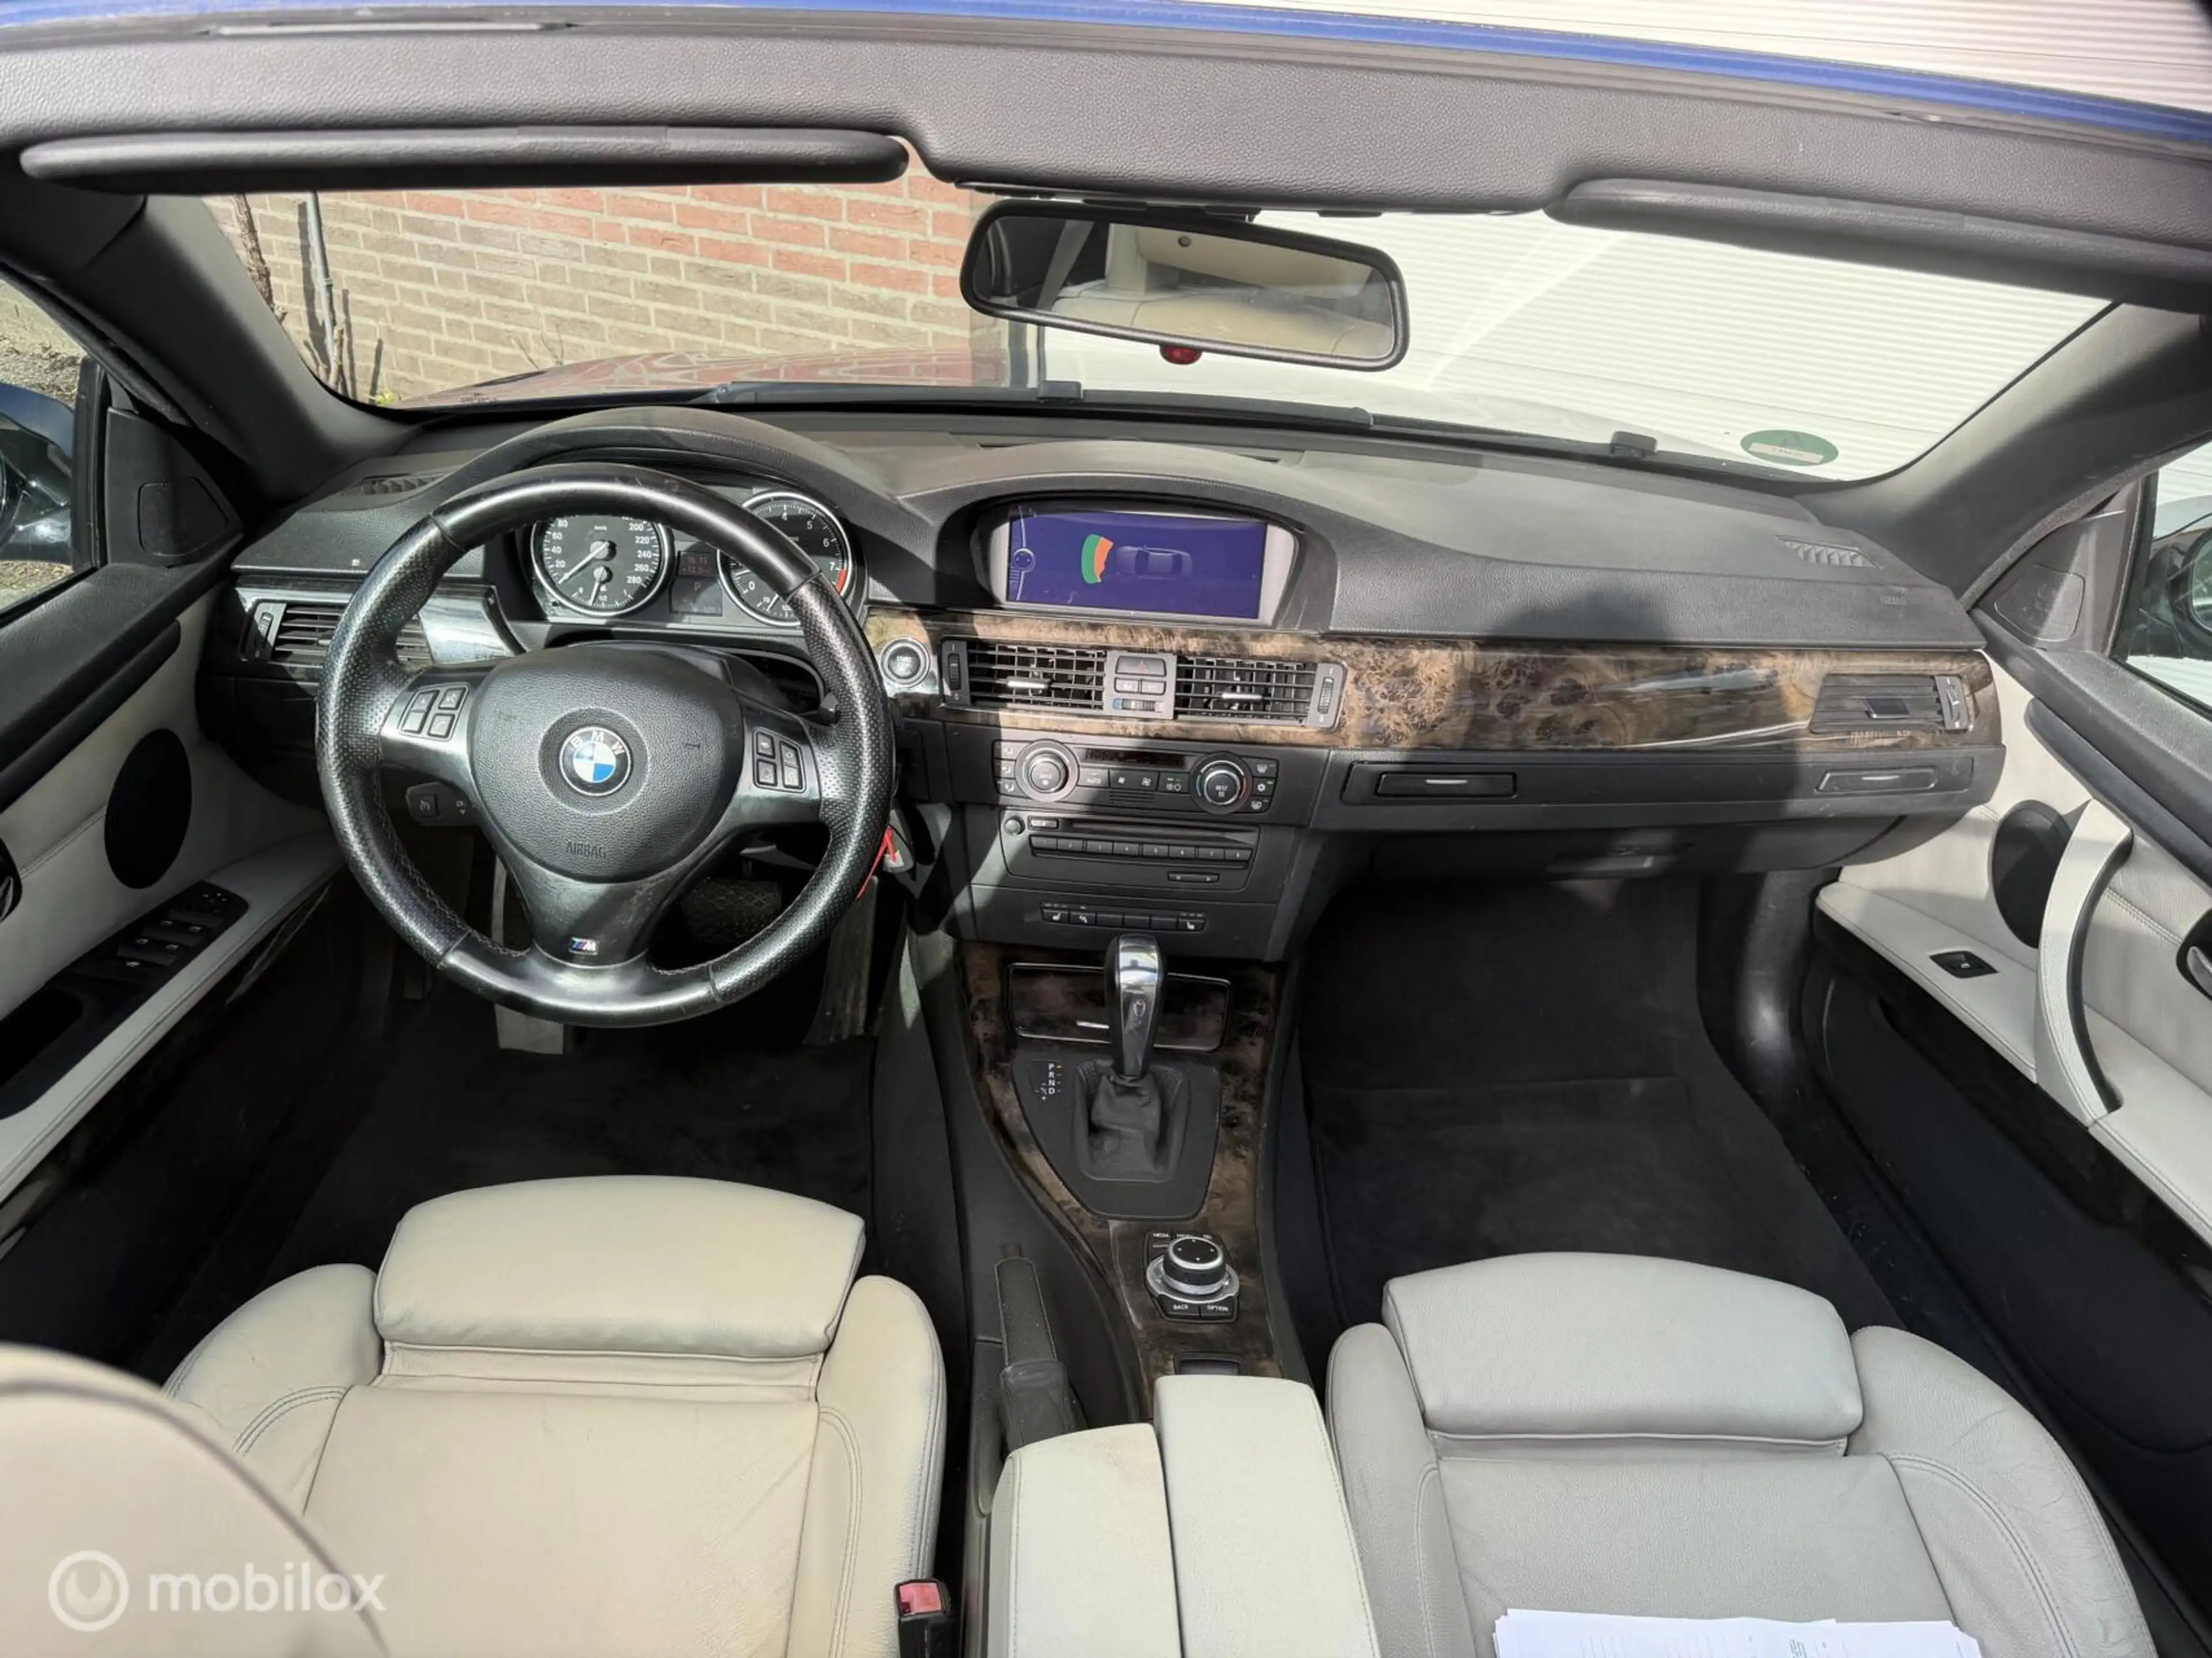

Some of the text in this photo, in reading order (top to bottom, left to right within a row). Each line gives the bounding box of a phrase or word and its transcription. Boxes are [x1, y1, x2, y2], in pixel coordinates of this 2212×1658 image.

[781, 512, 787, 521] 4
[628, 522, 644, 532] 200
[806, 521, 813, 529] 5
[551, 532, 563, 540] 60
[635, 536, 650, 544] 220
[823, 538, 830, 547] 6
[551, 546, 562, 554] 40
[637, 550, 652, 559] 240
[555, 559, 566, 568] 20
[829, 562, 835, 571] 7
[748, 581, 755, 590] 0
[569, 730, 626, 756] BMW
[565, 841, 607, 860] AIRBAG
[1048, 1087, 1055, 1095] D
